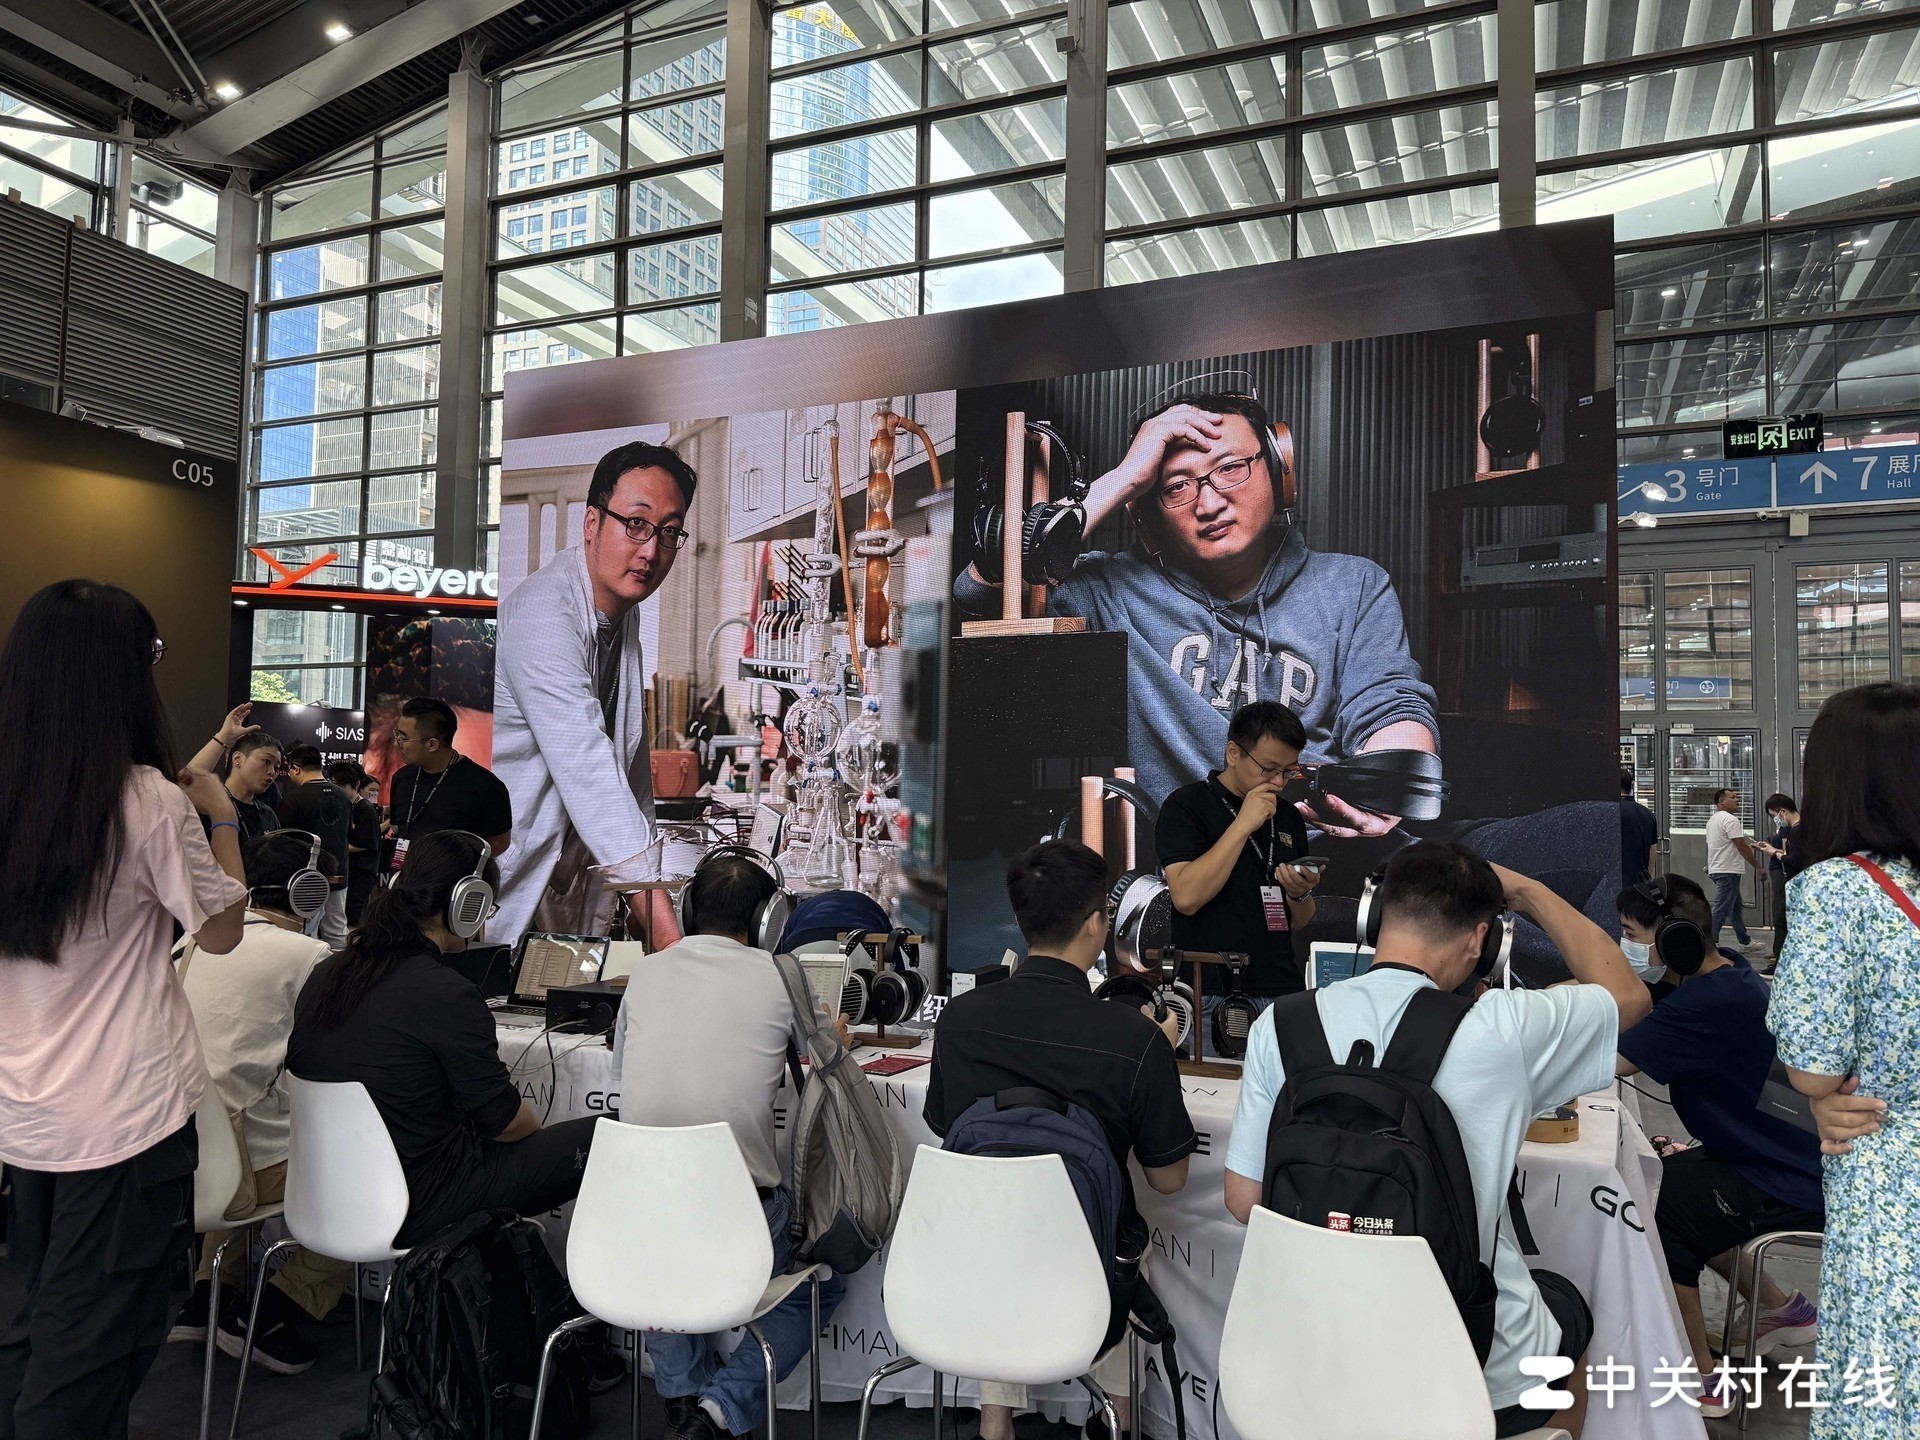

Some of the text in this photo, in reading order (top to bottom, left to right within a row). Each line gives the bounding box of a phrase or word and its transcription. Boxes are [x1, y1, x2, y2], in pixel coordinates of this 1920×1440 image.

[1730, 433, 1756, 446] 安全出口
[1789, 427, 1816, 441] EXIT
[172, 459, 214, 487] C05
[1852, 456, 1878, 491] 7
[1663, 467, 1739, 503] 3 号门
[1887, 479, 1912, 489] Hall
[1695, 491, 1722, 501] Gate
[1170, 633, 1317, 710] GAP
[1329, 1216, 1394, 1229] 头条 今日头条
